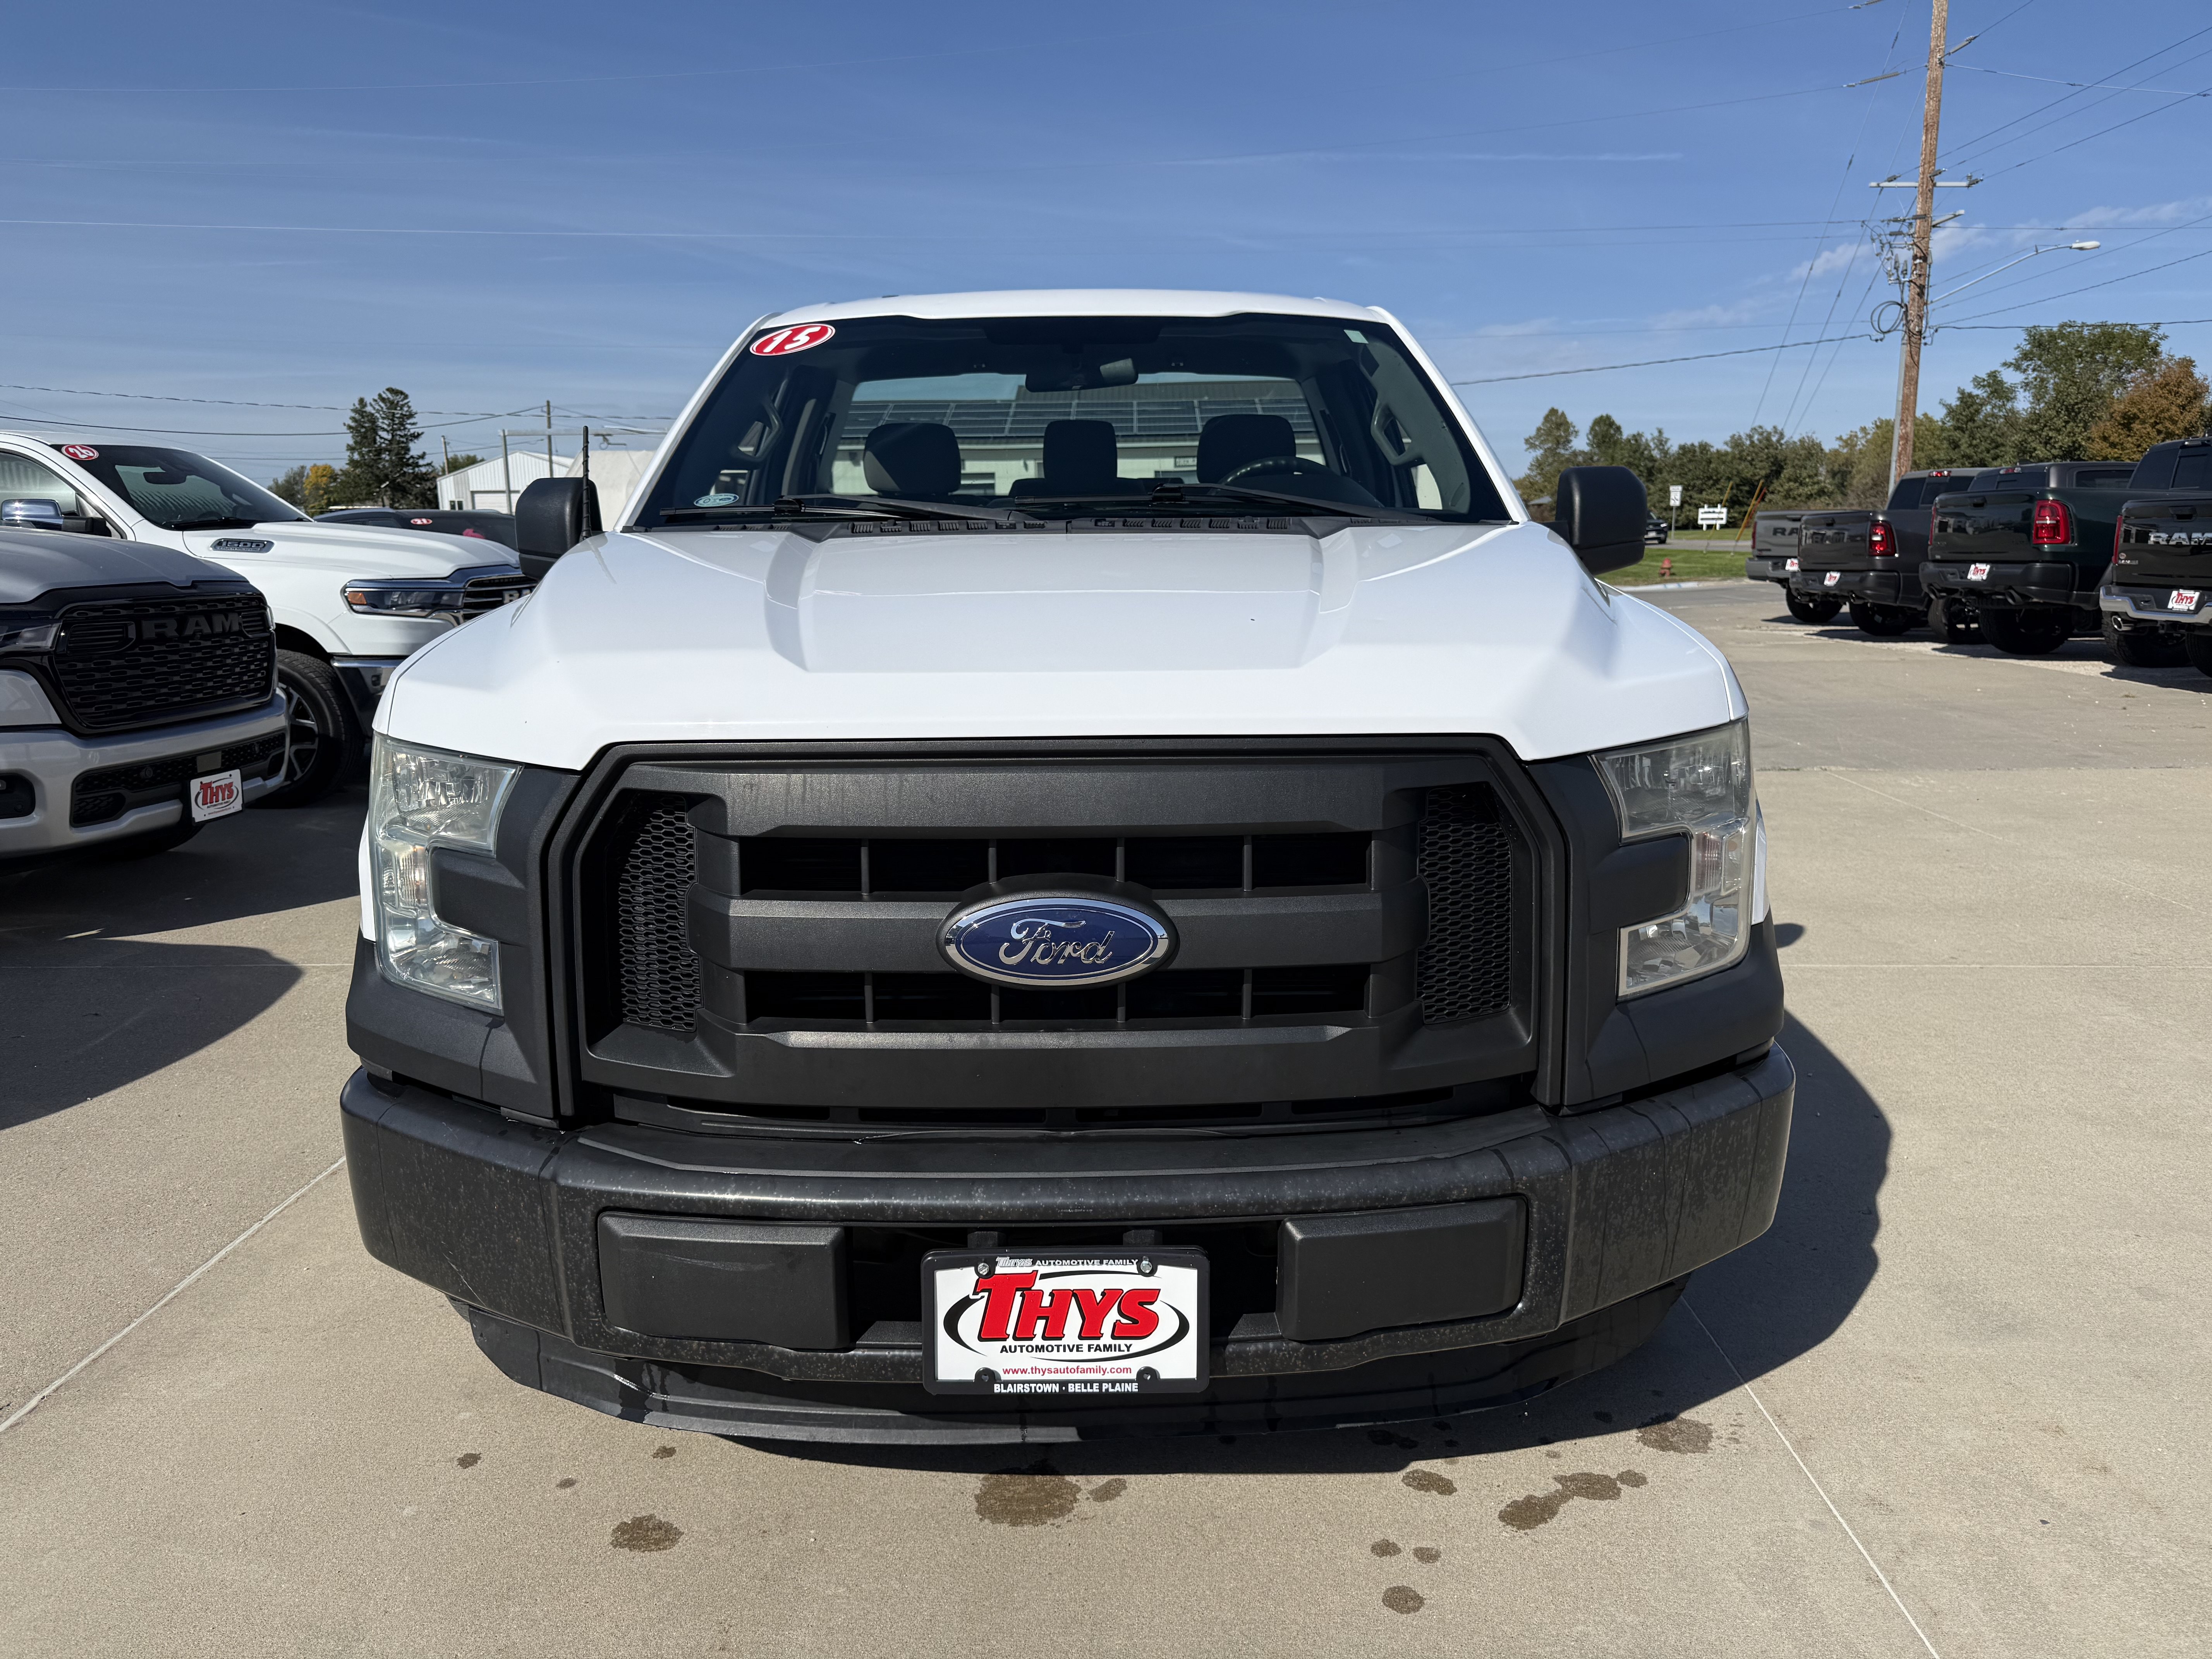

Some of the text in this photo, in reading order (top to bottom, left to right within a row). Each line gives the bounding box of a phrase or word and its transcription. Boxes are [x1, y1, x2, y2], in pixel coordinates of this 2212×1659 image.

[763, 326, 821, 353] 15
[68, 446, 94, 459] 26
[1772, 527, 1798, 536] RA
[2174, 592, 2195, 604] THYS
[142, 612, 239, 639] RAM
[200, 781, 234, 806] THYS
[998, 918, 1115, 965] Ford
[975, 1270, 1161, 1341] THYS
[1000, 1343, 1133, 1353] AUTOMOTIVE FAMILY
[1002, 1365, 1132, 1376] www.thysautofamily.com
[994, 1382, 1139, 1393] BLAIRSTOWN BELLE PLAINE
